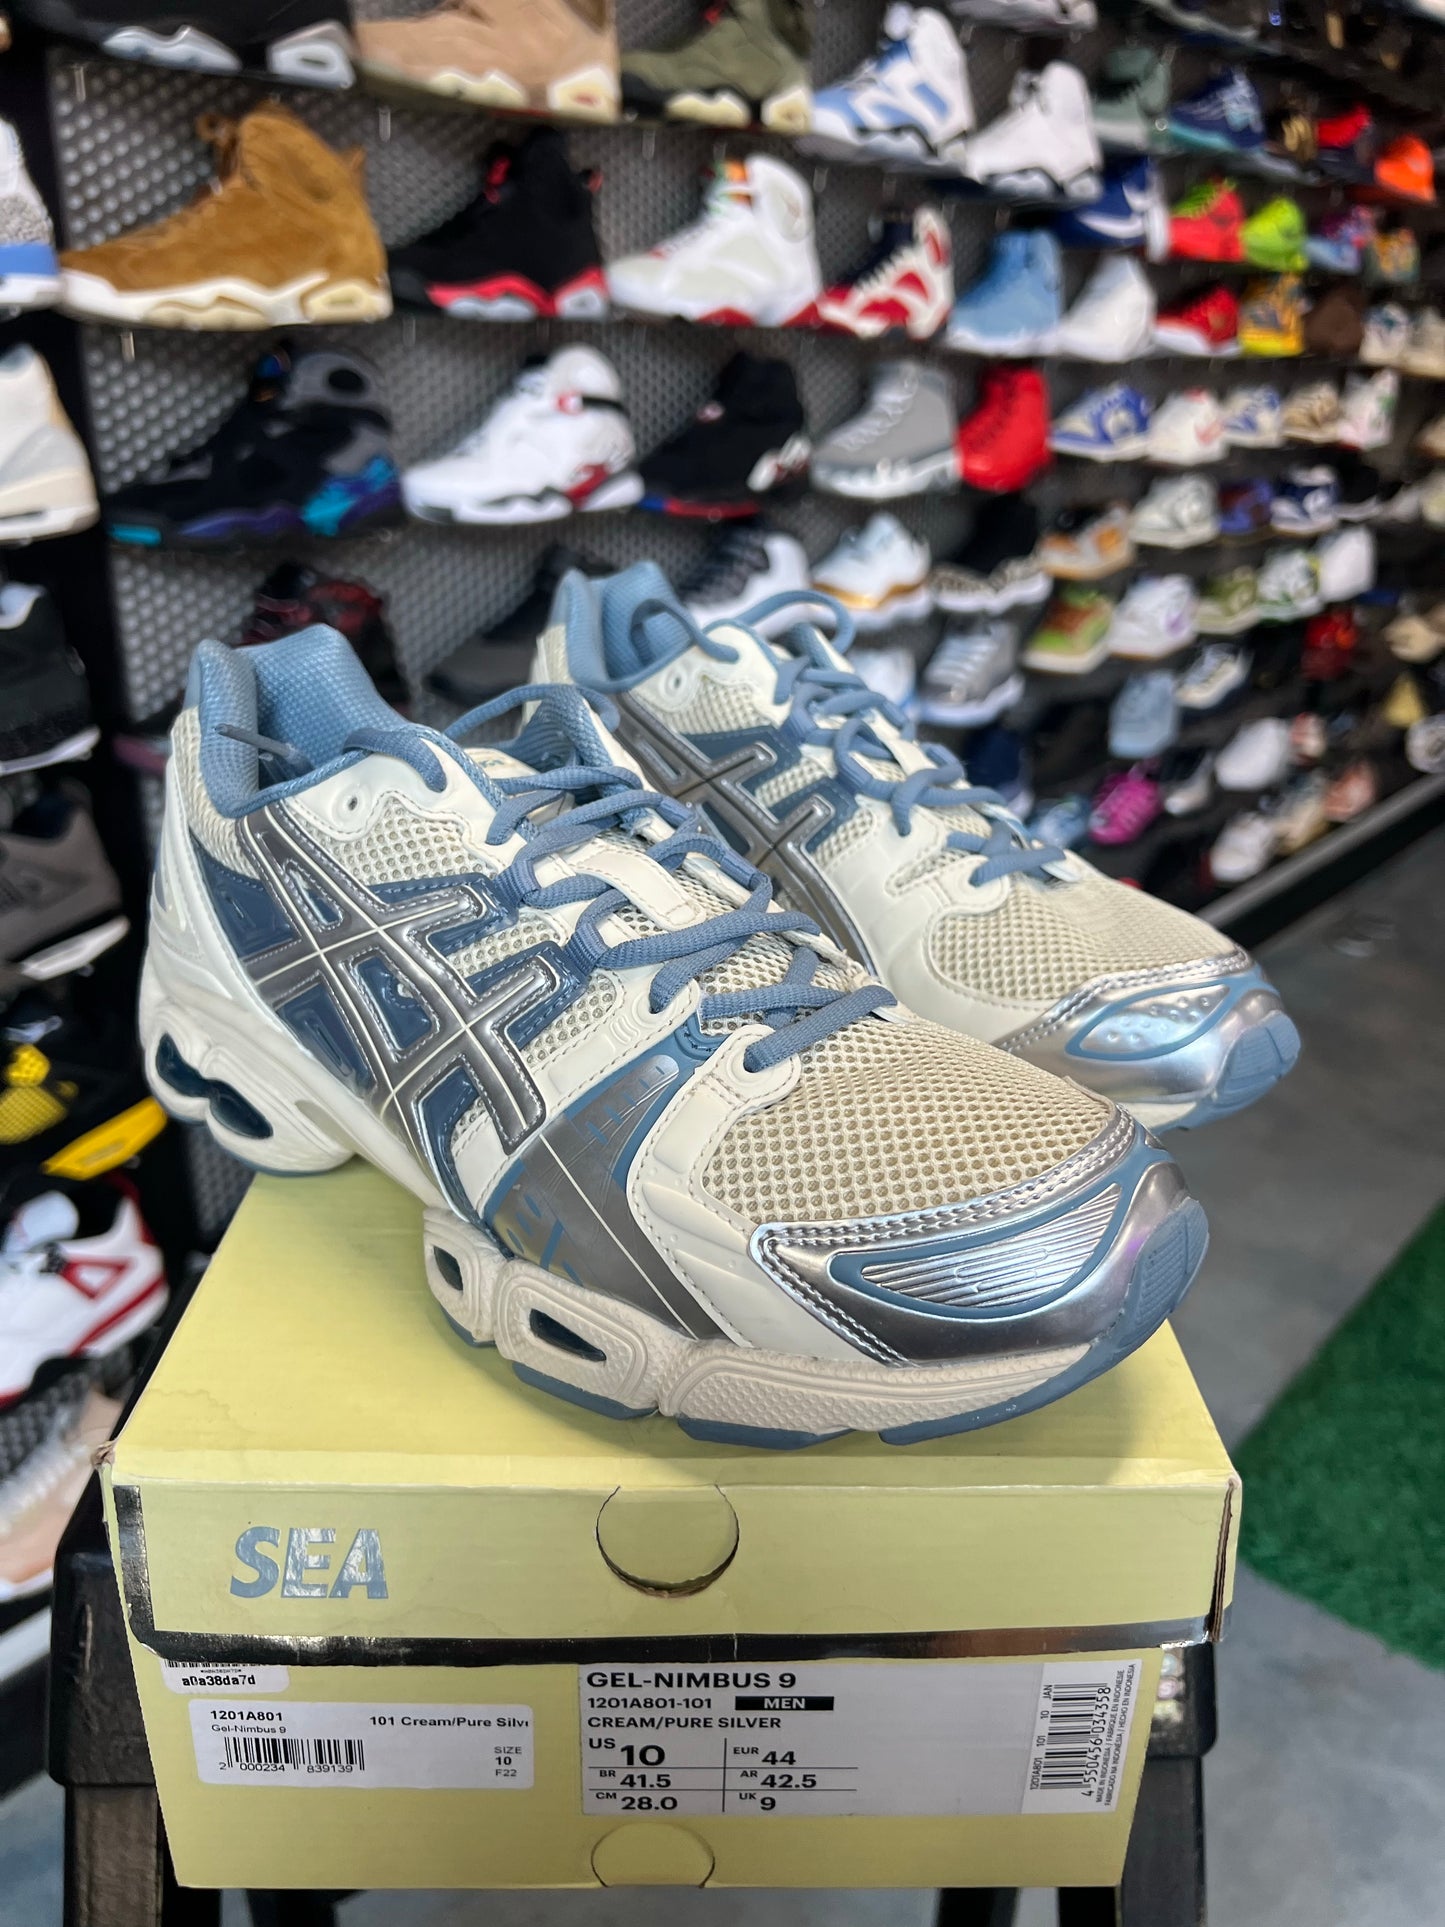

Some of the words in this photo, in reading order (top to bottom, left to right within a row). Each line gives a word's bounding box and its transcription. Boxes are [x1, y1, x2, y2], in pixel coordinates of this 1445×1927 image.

[230, 1526, 389, 1599] SEA
[587, 1672, 770, 1689] GEL-NIMBUS
[778, 1672, 796, 1689] 9
[1043, 1685, 1052, 1699] JAN
[587, 1697, 712, 1709] 1201A801-101
[763, 1698, 805, 1710] MEN
[210, 1710, 282, 1721] 1201A801
[1041, 1710, 1049, 1719] 10
[1091, 1687, 1111, 1734] 034358
[369, 1716, 395, 1726] 101
[401, 1716, 492, 1727] Cream/Pure
[587, 1716, 713, 1729] CREAM/PURE
[718, 1717, 782, 1729] SILVER
[211, 1724, 276, 1733] Gel-Nimbus
[1036, 1736, 1046, 1747] 101
[494, 1746, 522, 1754] SIZE
[588, 1738, 616, 1749] US
[620, 1745, 665, 1766] 10
[733, 1746, 759, 1755] EUR
[762, 1750, 796, 1765] 44
[495, 1756, 512, 1765] 10
[1084, 1738, 1103, 1784] 550456
[219, 1762, 227, 1770] 2
[240, 1762, 285, 1772] 000234
[307, 1764, 353, 1773] 839139
[495, 1769, 517, 1777] F22
[599, 1769, 616, 1778] BR
[620, 1774, 671, 1788] 41.5
[740, 1770, 758, 1778] AR
[760, 1774, 817, 1788] 42.5
[596, 1792, 617, 1800] CM
[621, 1796, 678, 1811] 28.0
[739, 1792, 757, 1800] UK
[760, 1796, 776, 1811] 9
